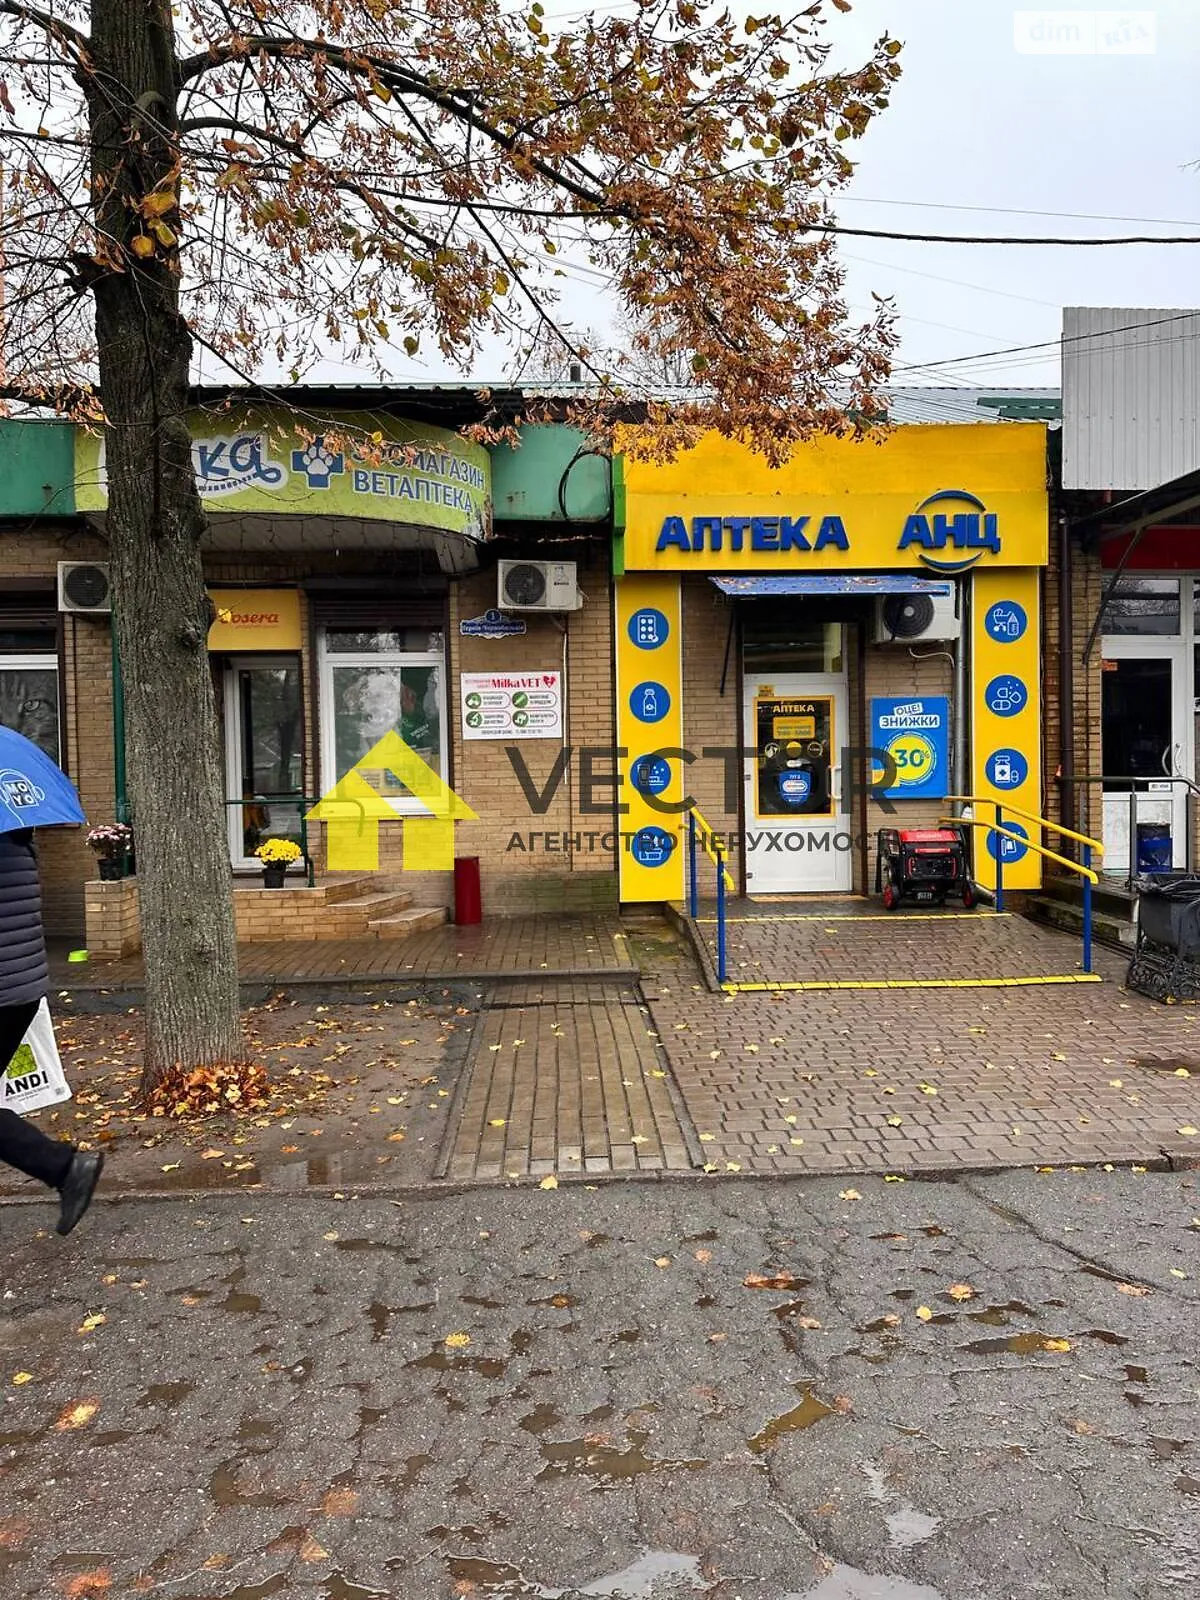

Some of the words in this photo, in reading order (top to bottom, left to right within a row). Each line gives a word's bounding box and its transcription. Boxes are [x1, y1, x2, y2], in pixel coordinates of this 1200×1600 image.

[354, 470, 473, 512] ВЕТАПТЕКА
[655, 514, 850, 552] АПТЕКА
[897, 512, 1001, 554] АНЦ
[219, 612, 280, 624] osera
[773, 704, 815, 713] АПТЕКА
[881, 717, 938, 727] ЗНИЖКИ
[5, 782, 28, 794] MO
[12, 794, 35, 806] YO
